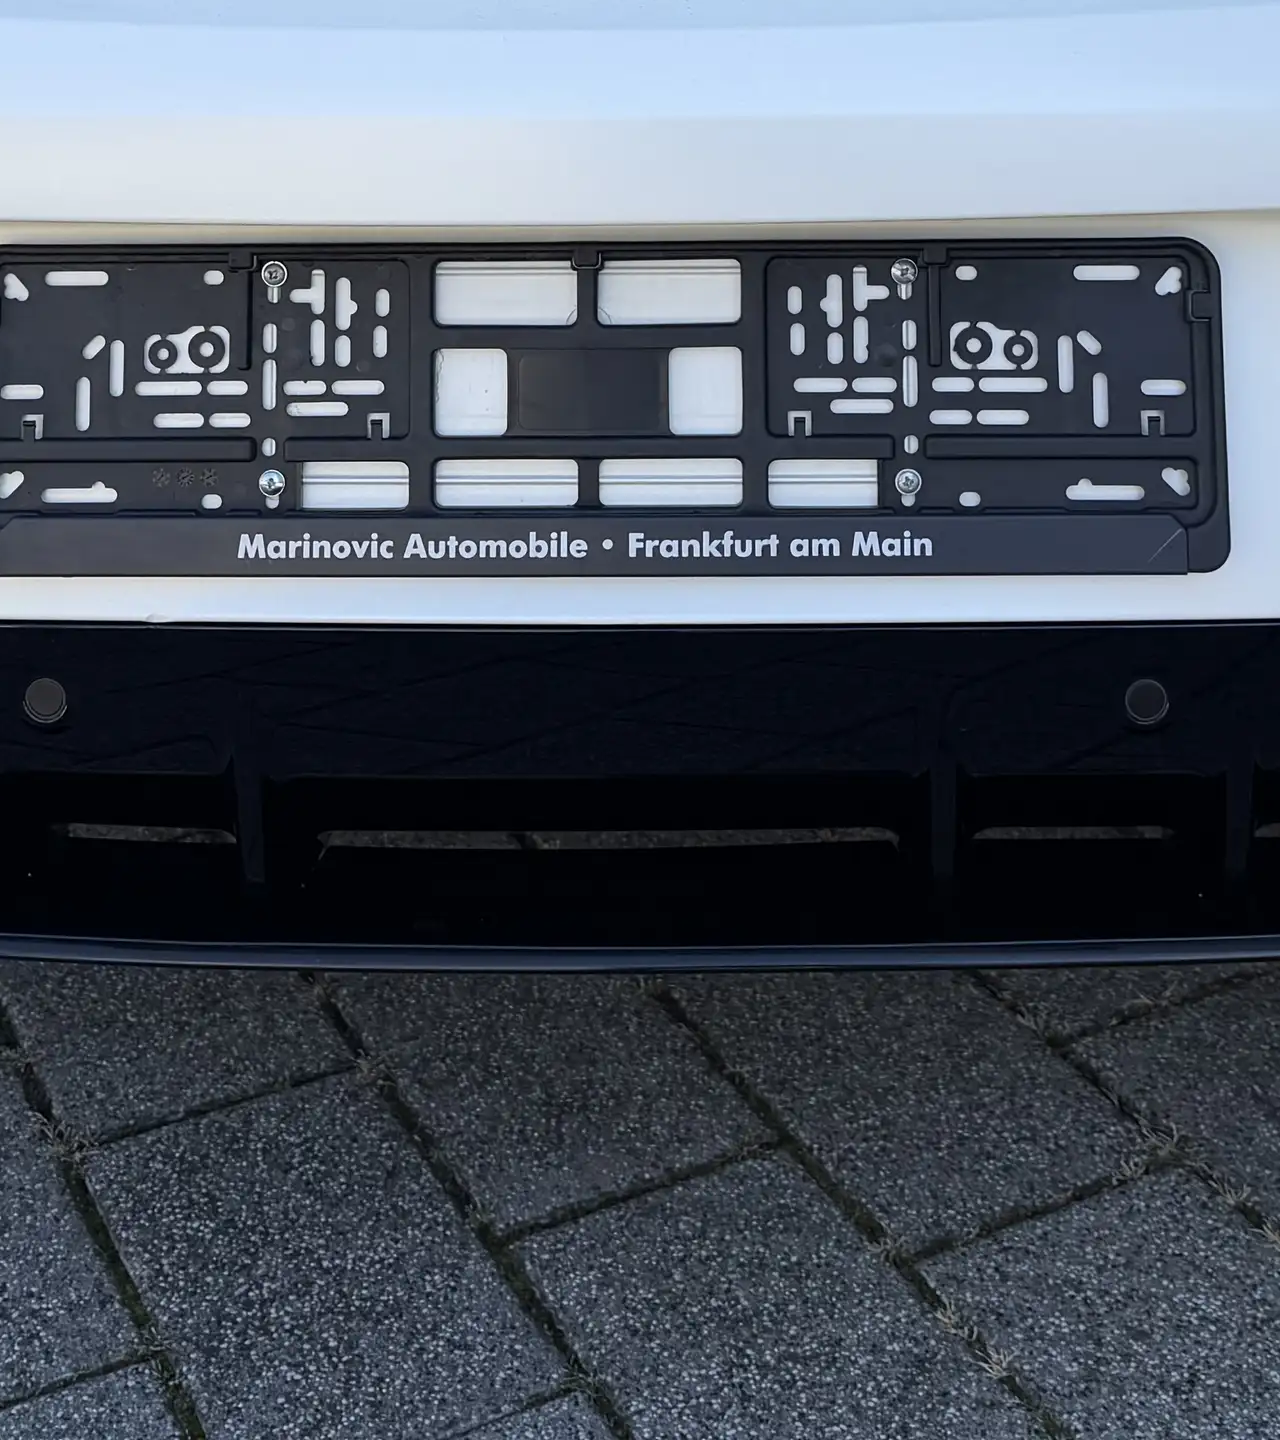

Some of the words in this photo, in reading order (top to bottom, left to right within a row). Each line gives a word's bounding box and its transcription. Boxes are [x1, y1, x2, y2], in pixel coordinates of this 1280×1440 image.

[237, 532, 394, 560] Marinovic
[403, 530, 588, 559] Automobile
[628, 530, 780, 559] Frankfurt
[789, 538, 841, 558] am
[851, 530, 933, 557] Main
